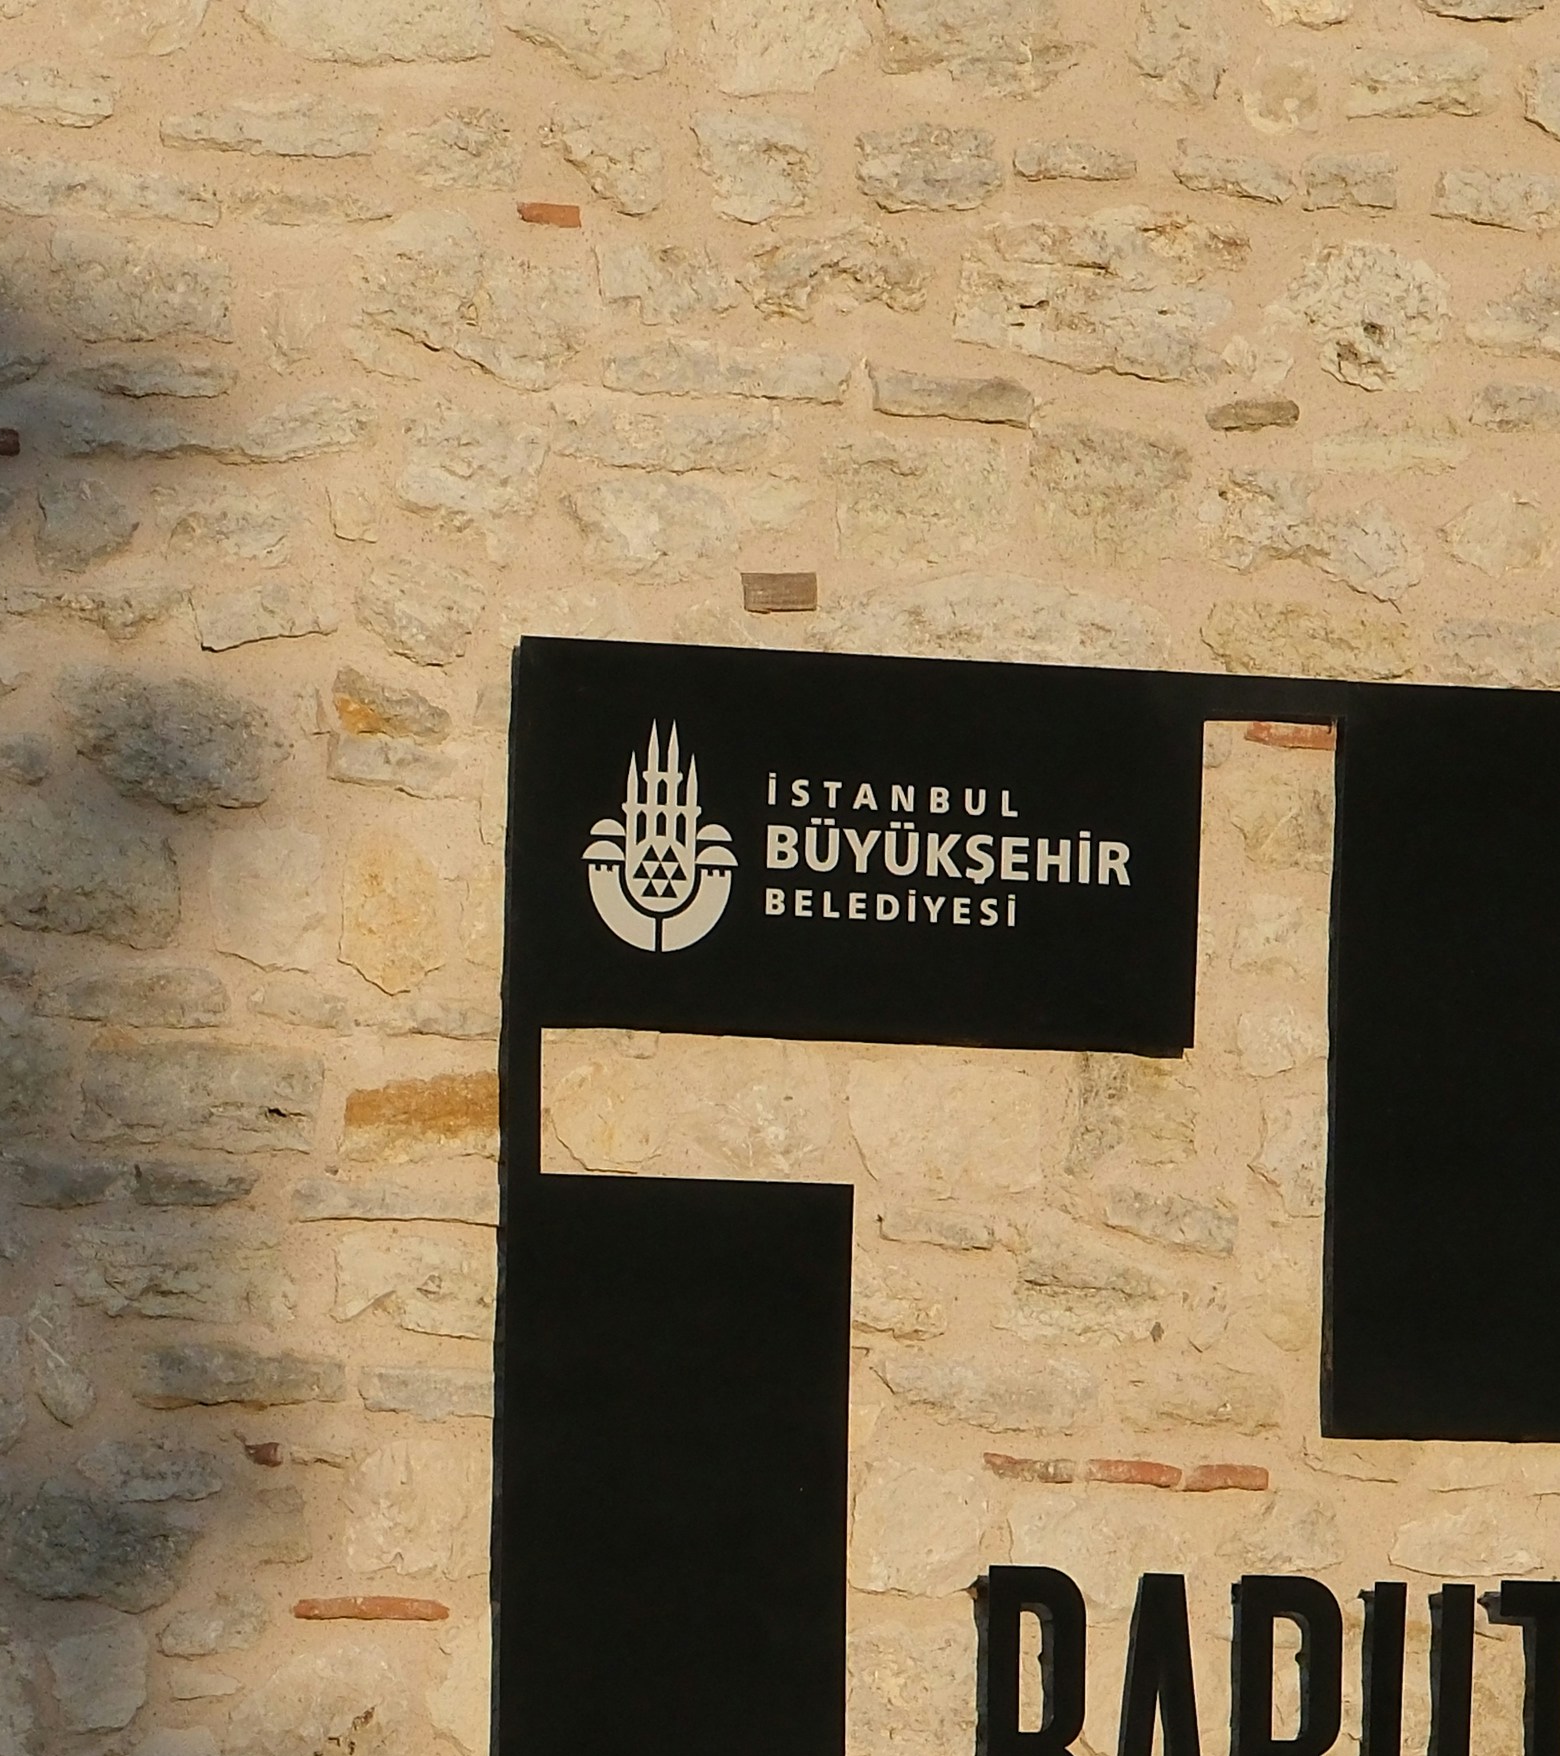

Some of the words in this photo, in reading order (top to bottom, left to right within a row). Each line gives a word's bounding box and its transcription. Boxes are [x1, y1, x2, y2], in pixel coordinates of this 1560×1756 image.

[767, 771, 1020, 818] İSTANBUL
[765, 817, 1132, 886] BÜYÜKŞEHİR
[764, 886, 1018, 928] BELEDİYESİ
